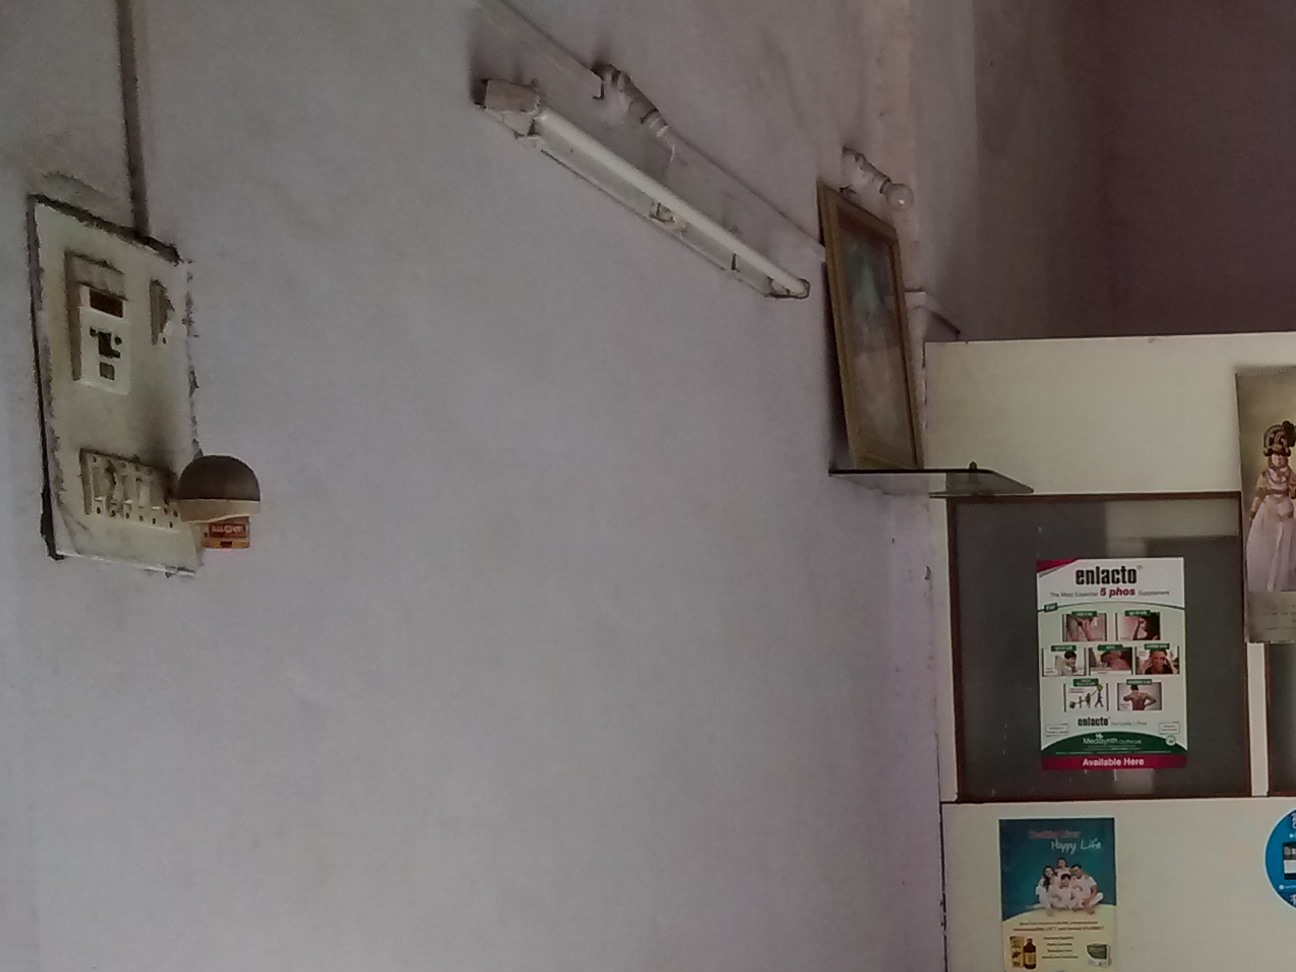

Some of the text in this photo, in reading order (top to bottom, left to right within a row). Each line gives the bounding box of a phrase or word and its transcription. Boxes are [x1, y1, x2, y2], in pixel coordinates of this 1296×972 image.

[1075, 566, 1138, 585] enlacto
[1109, 587, 1136, 598] phos
[1077, 717, 1109, 726] enlacto
[1082, 757, 1145, 767] Available Here
[1051, 837, 1102, 855] Happy Life
